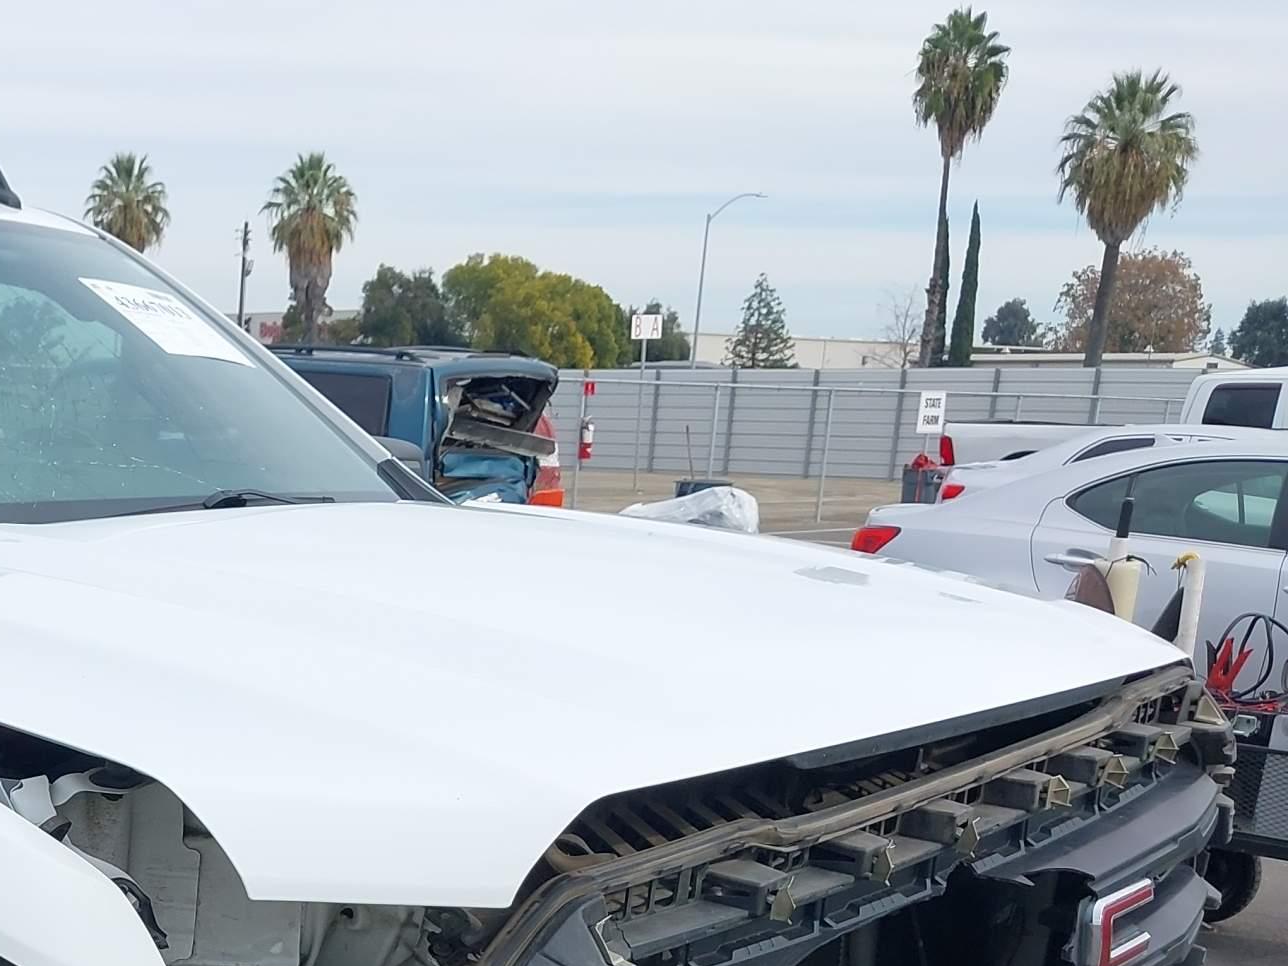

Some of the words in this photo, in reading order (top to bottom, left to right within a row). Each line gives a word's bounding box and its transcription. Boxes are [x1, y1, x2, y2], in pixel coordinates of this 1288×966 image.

[634, 315, 643, 338] B
[650, 316, 661, 337] A
[923, 397, 943, 409] STATE
[921, 415, 940, 425] FARM
